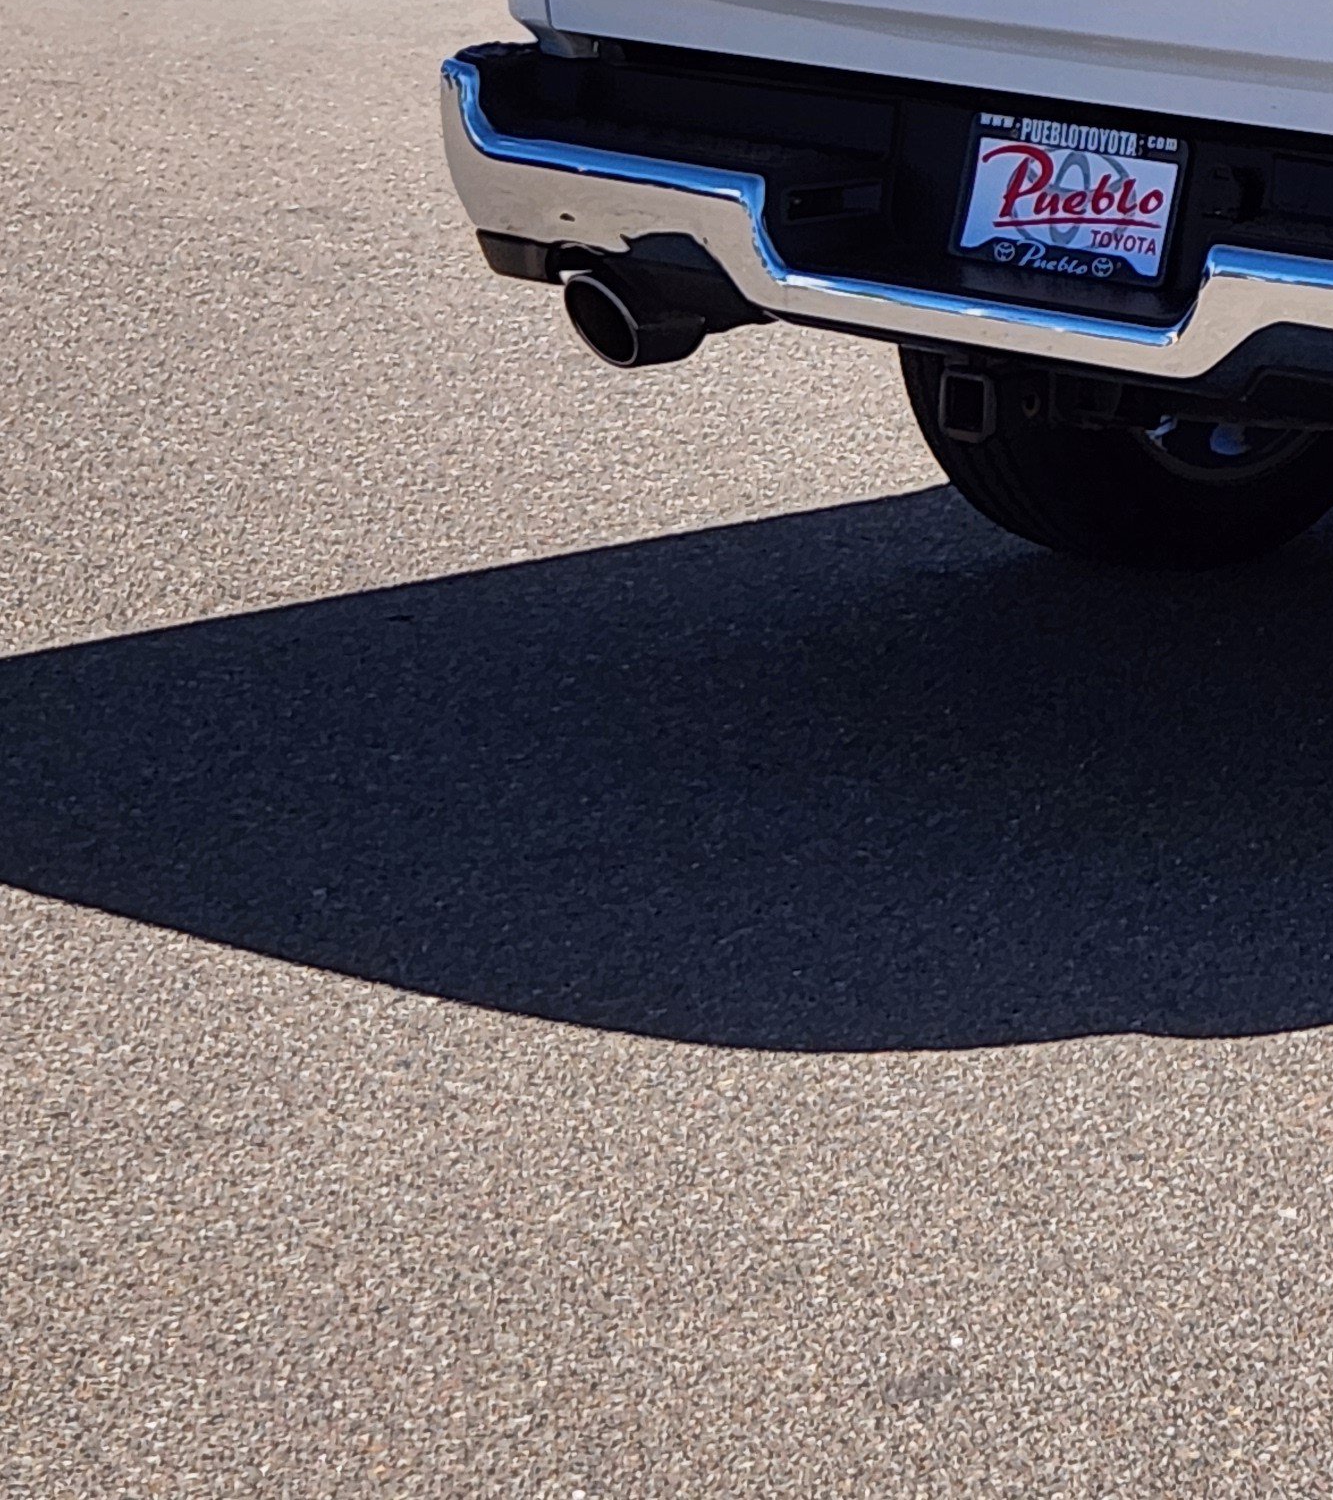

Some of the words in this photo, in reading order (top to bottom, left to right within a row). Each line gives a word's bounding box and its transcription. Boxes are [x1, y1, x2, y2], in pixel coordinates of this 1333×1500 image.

[981, 144, 1165, 219] Pueblo
[1015, 238, 1089, 275] Pueblo
[1090, 229, 1157, 256] TOYOTA
